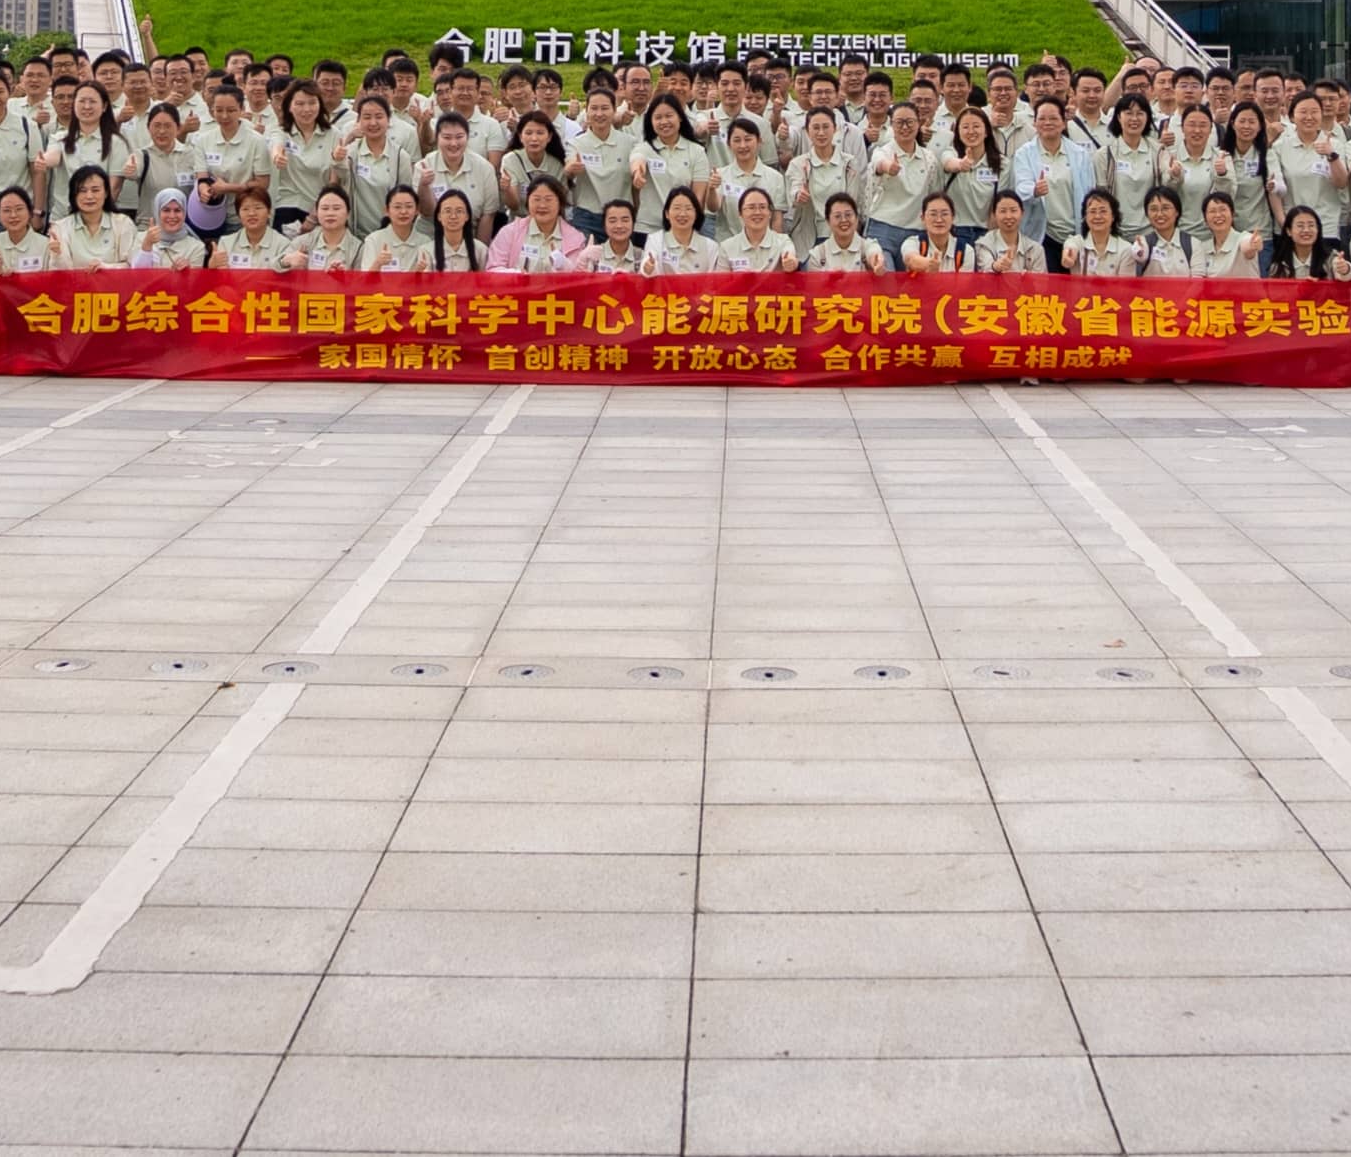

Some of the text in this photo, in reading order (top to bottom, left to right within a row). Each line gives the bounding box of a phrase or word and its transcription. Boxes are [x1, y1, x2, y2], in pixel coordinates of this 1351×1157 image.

[435, 27, 728, 67] 合肥市科技馆
[737, 33, 907, 50] HEFEI SCIENCE
[788, 51, 921, 67] TECHLOG
[318, 343, 1133, 371] 家国情怀 首创精神 开放心态 合作共赢 互相成就
